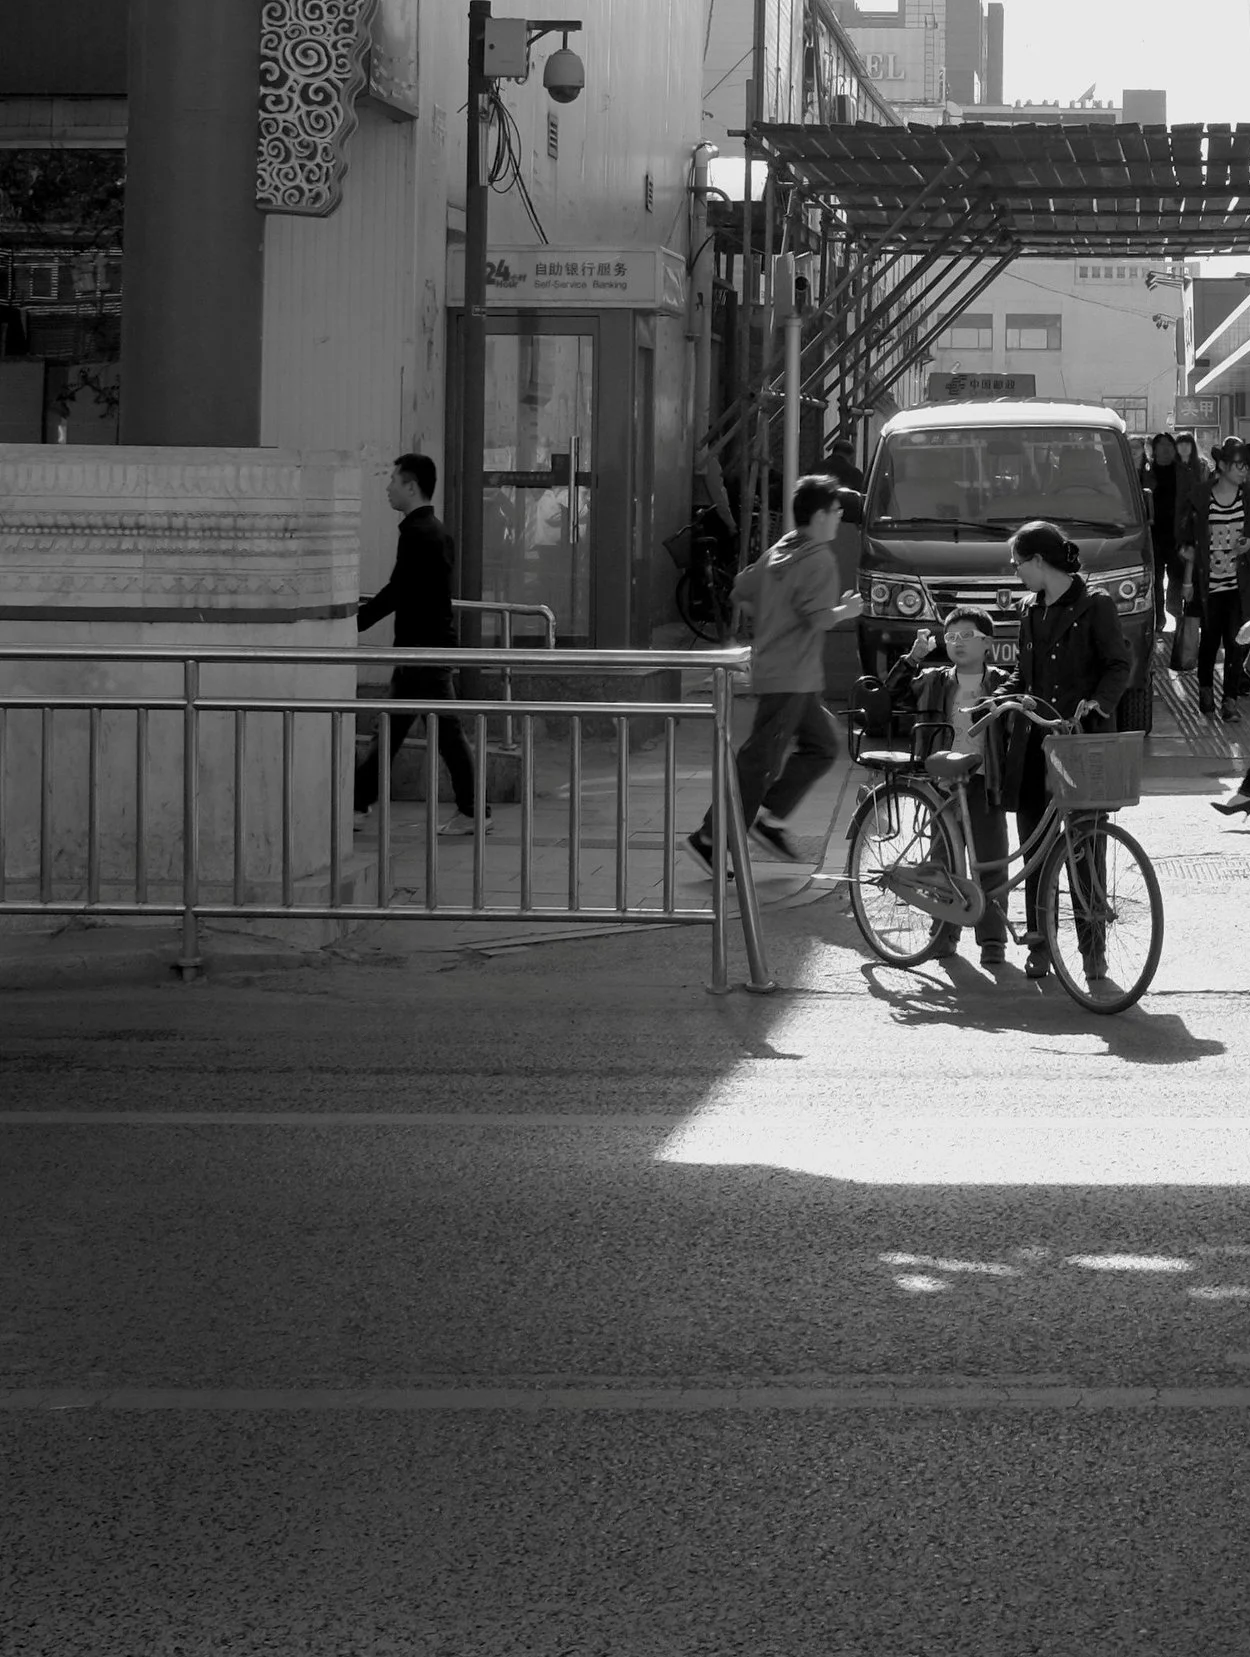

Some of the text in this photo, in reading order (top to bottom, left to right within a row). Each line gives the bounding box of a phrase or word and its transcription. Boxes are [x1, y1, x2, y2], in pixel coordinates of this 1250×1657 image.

[486, 259, 510, 285] 24
[535, 262, 627, 277] 自助银行服务
[592, 280, 627, 291] Banking
